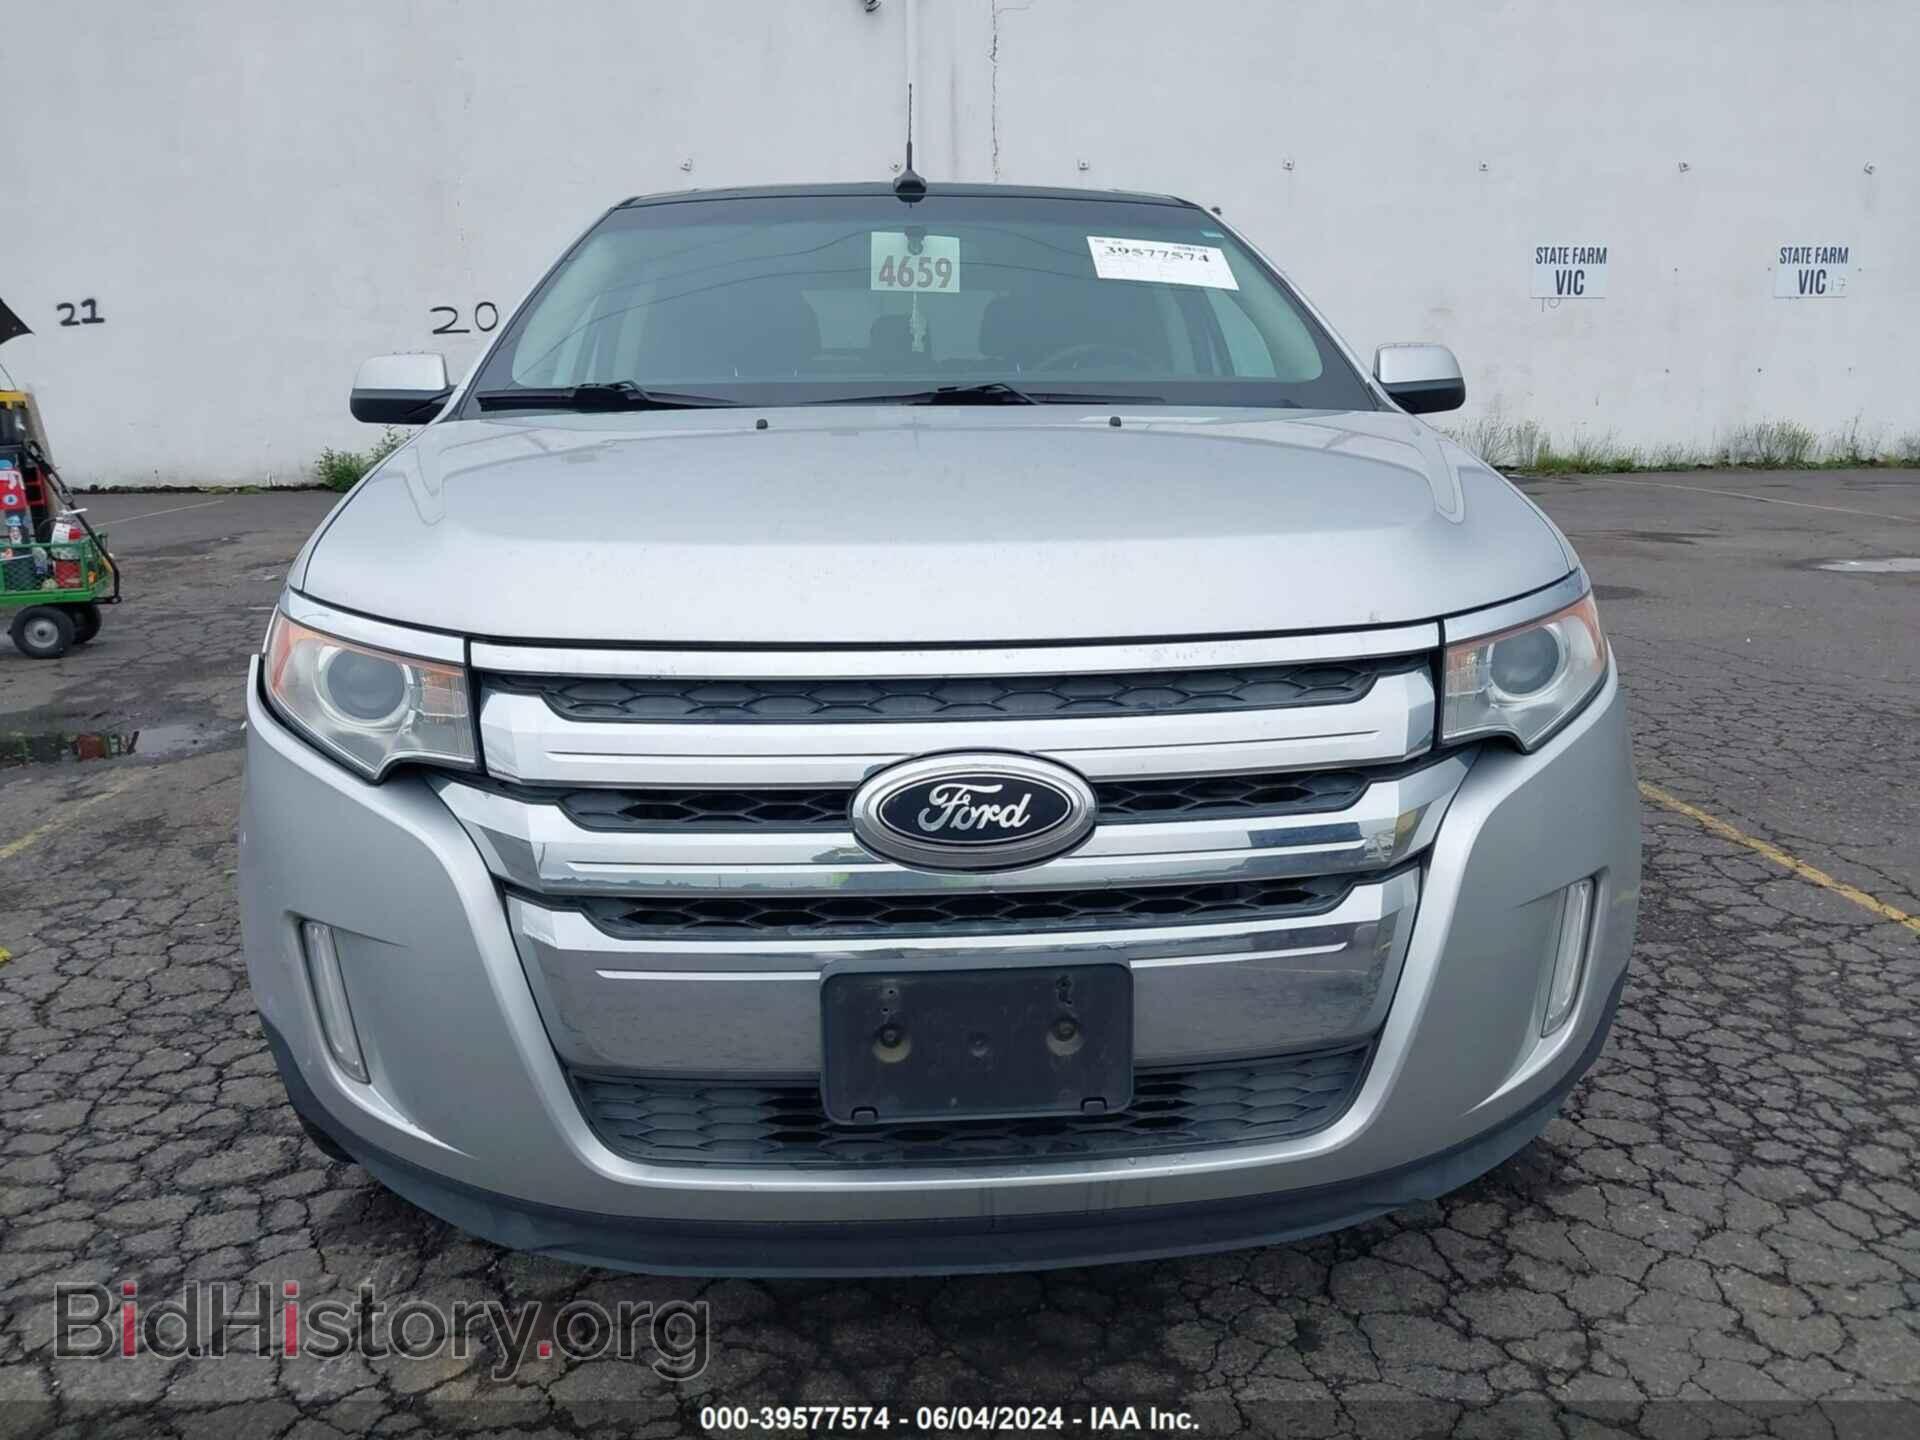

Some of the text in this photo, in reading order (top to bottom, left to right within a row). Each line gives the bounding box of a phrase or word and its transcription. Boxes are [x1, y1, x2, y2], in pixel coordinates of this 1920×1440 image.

[1104, 245, 1210, 263] 39577574
[1536, 246, 1607, 265] STATE FARM
[1780, 246, 1849, 265] STATE FARM
[879, 255, 953, 288] 4659
[1555, 269, 1585, 296] VIC
[1798, 269, 1827, 295] VIC
[56, 298, 105, 327] 21
[430, 301, 499, 334] 20
[917, 783, 1033, 832] Ford
